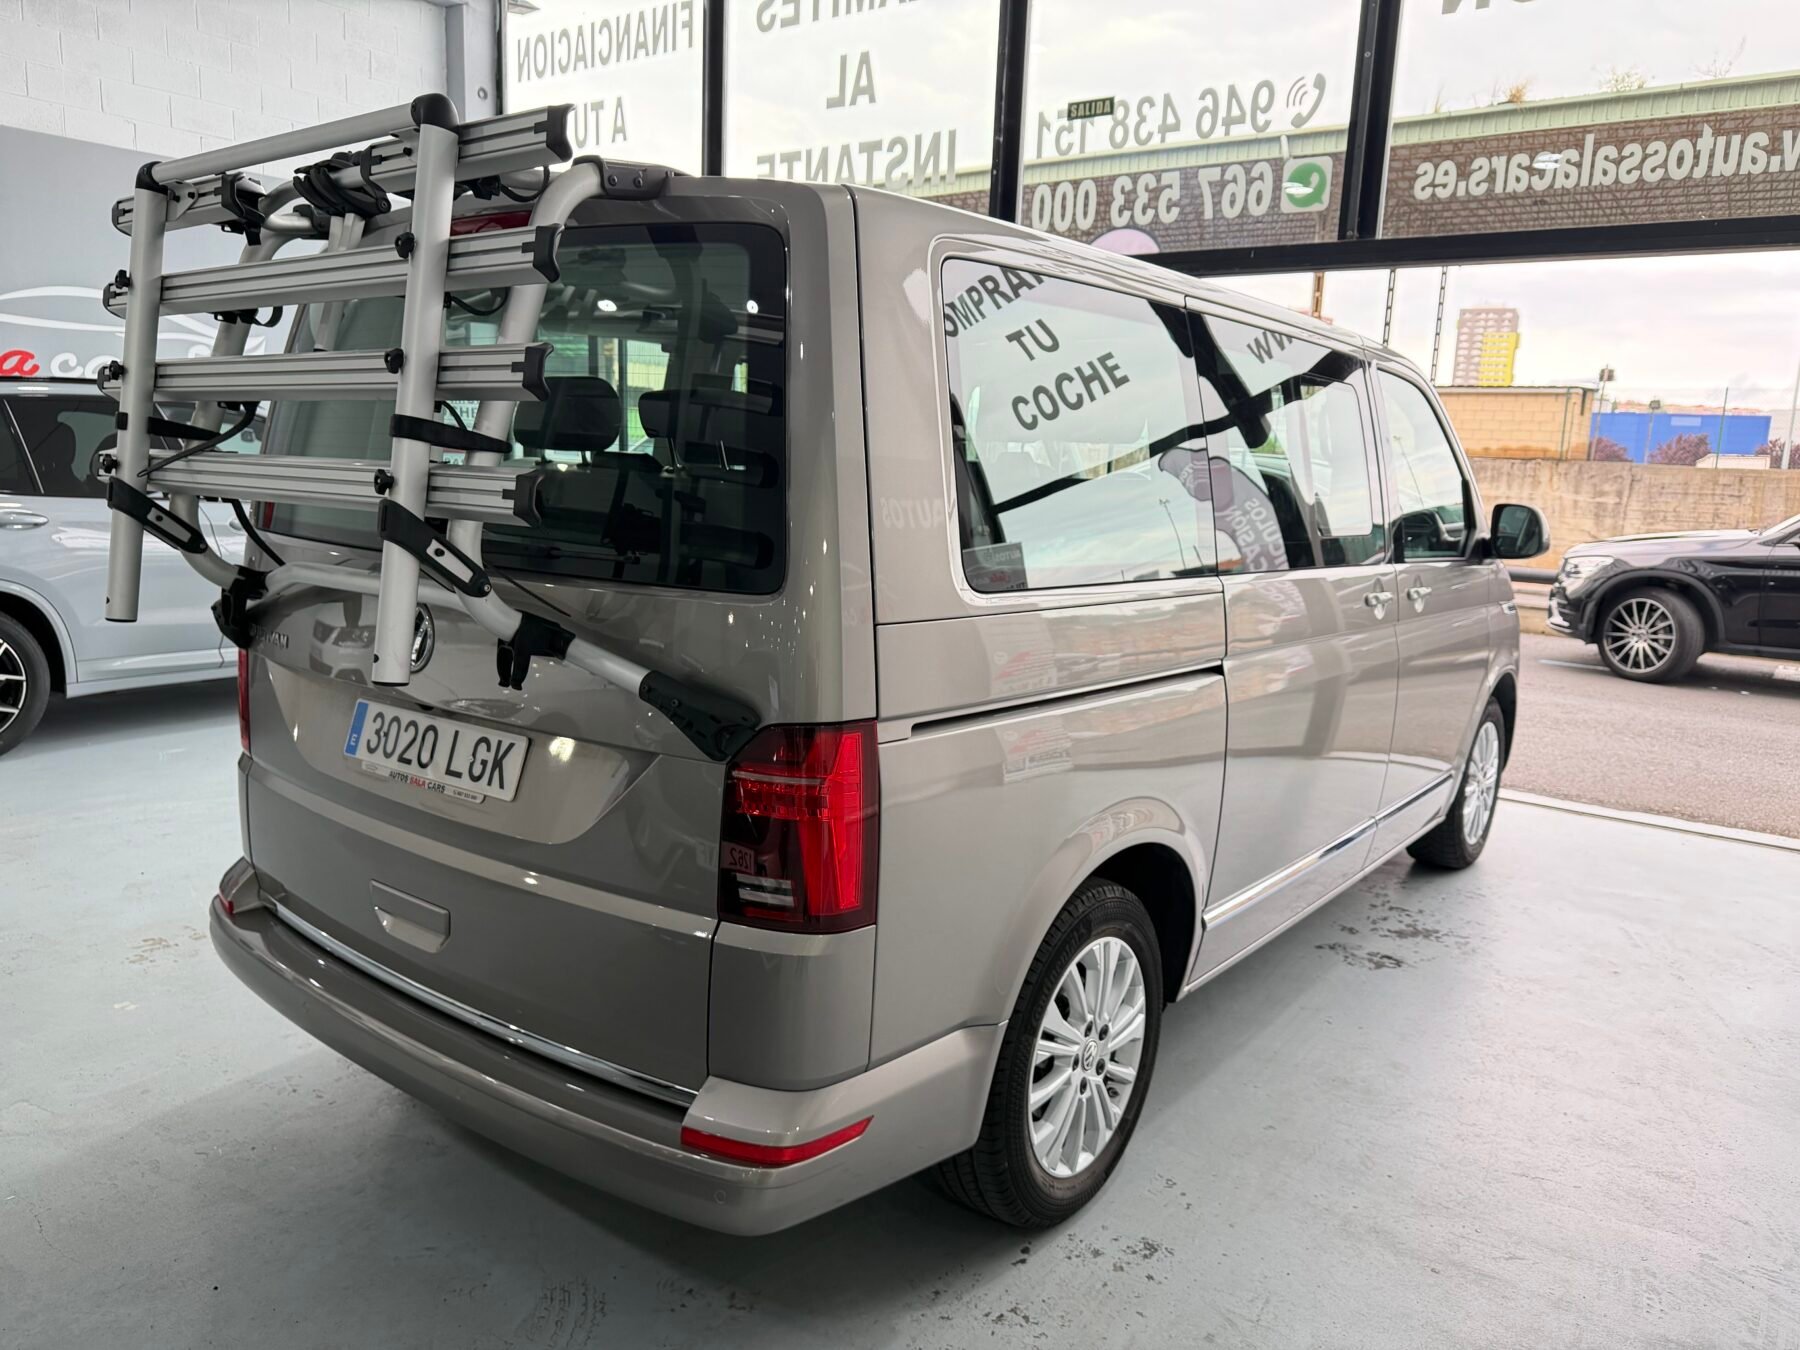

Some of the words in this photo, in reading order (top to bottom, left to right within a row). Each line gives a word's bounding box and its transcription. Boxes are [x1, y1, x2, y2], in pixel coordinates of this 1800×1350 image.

[1068, 98, 1112, 118] SALIDA
[1005, 318, 1060, 361] TU
[1011, 352, 1131, 431] COCHE
[366, 711, 439, 769] 3020
[445, 730, 516, 790] LGK
[389, 770, 409, 784] AUTOS
[409, 775, 426, 788] SALA
[427, 781, 446, 794] CARS
